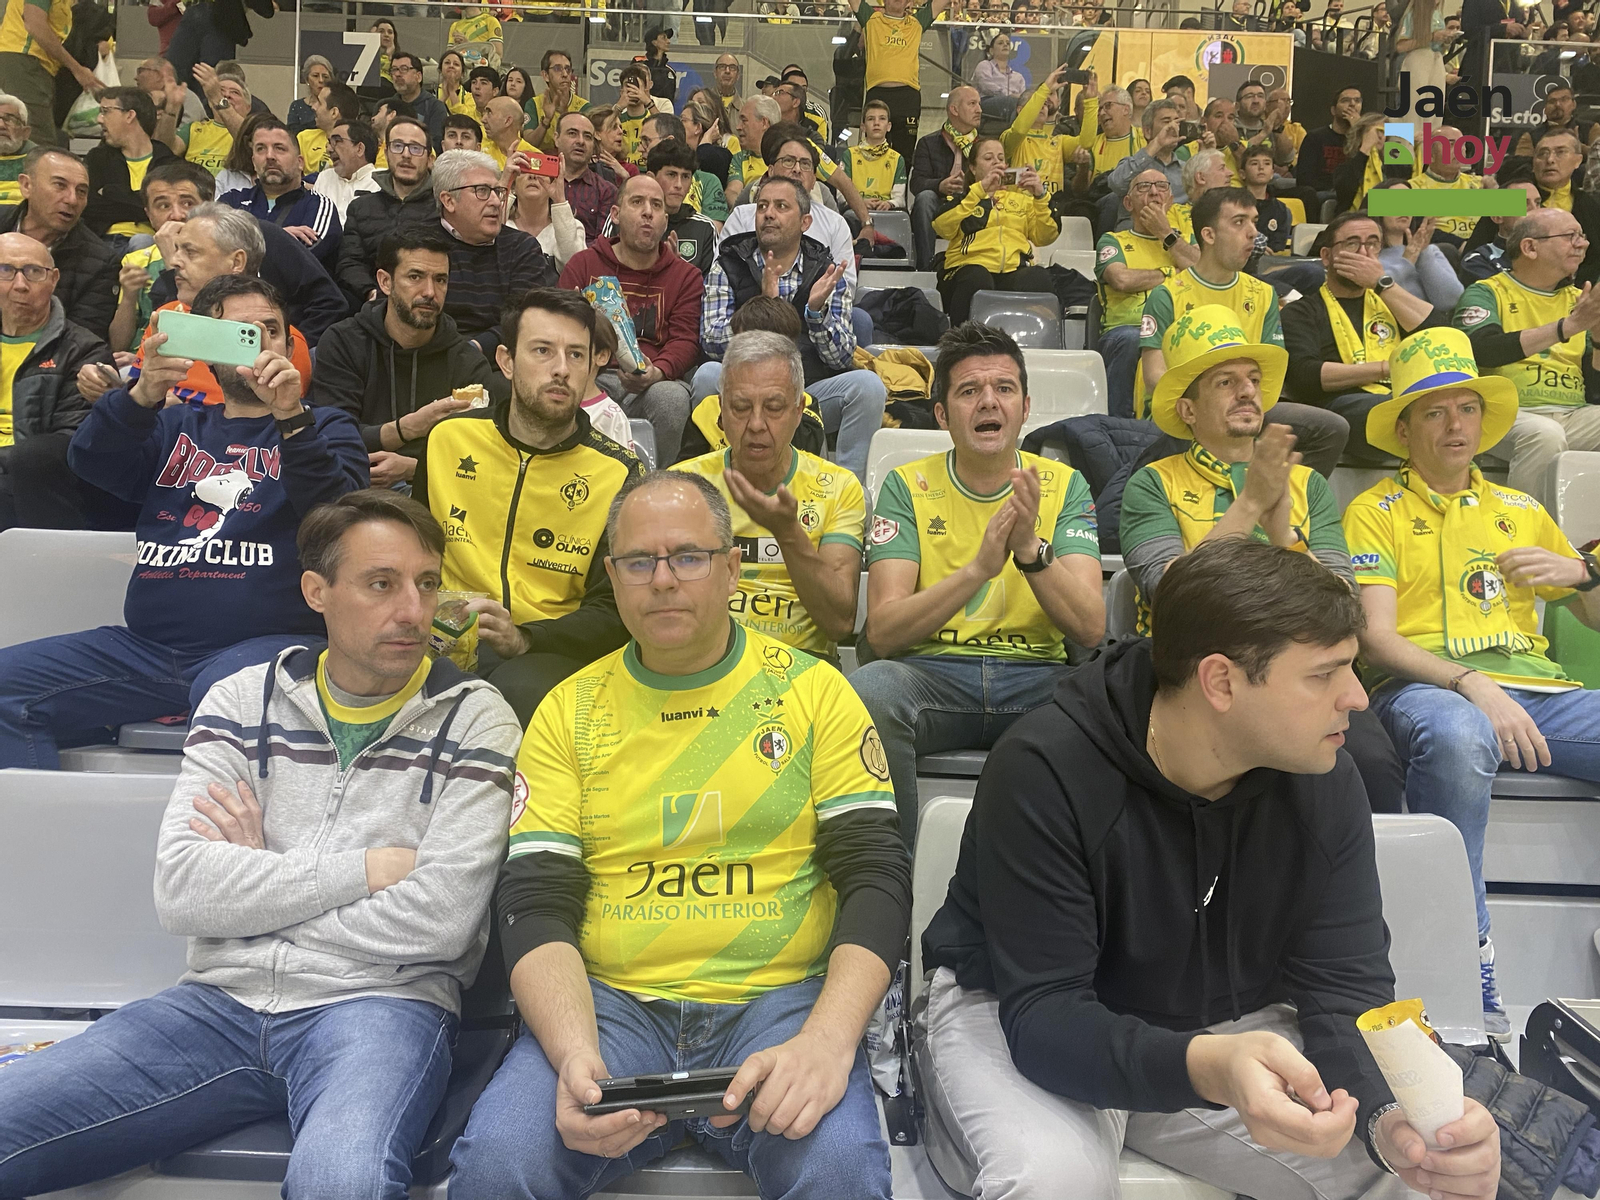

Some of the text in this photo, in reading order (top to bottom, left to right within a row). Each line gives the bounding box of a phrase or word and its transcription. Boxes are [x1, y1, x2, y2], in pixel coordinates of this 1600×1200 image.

[343, 31, 381, 85] 7
[1447, 217, 1477, 233] Jaé
[455, 471, 476, 481] luanvi
[557, 533, 592, 547] CLÍNICA
[205, 539, 274, 566] CLUB
[555, 542, 590, 556] OLMO
[178, 567, 247, 580] Department
[1469, 564, 1497, 573] JAEN
[728, 589, 795, 619] aén
[661, 708, 703, 722] luanvi
[760, 726, 783, 734] JAEN
[626, 854, 754, 899] Jaén
[602, 900, 781, 921] PARAÍSO INTERIOR
